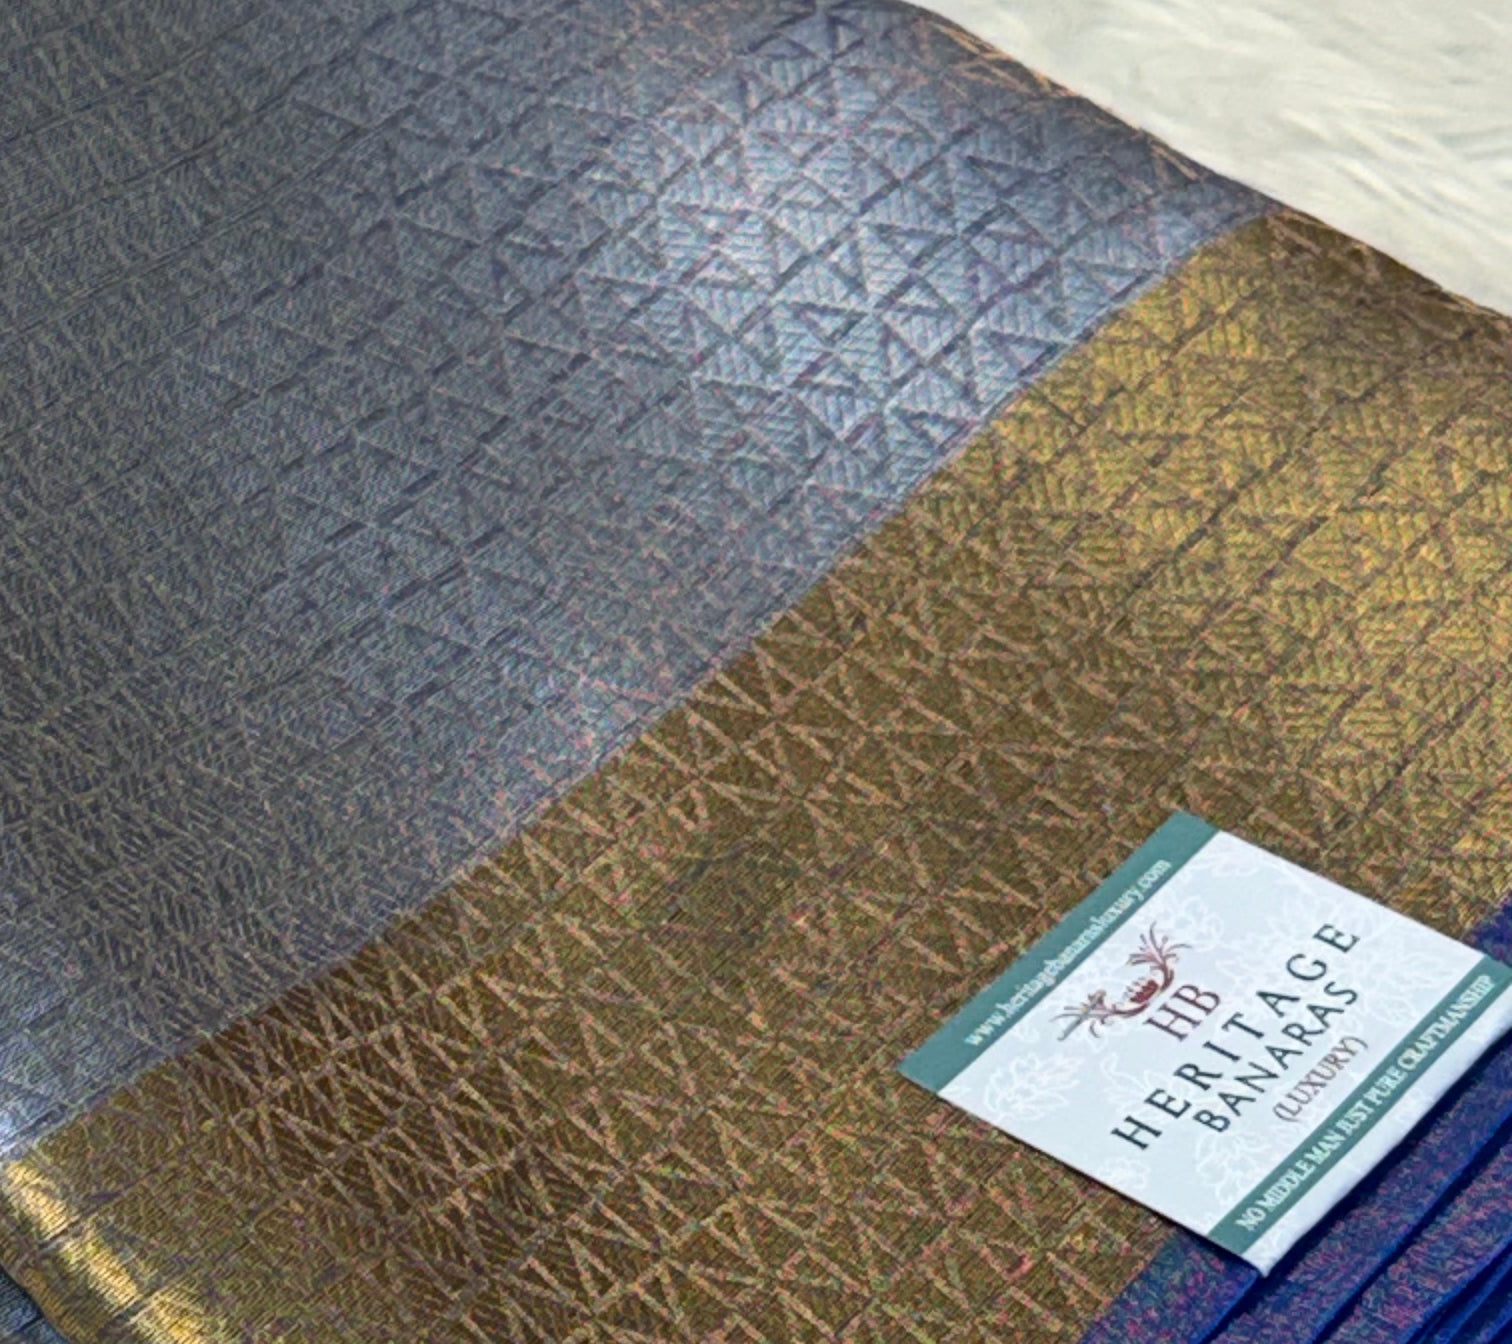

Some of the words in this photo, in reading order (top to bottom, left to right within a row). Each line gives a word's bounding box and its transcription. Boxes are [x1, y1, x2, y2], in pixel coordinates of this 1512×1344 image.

[1110, 923, 1360, 1150] HERITAGE
[1143, 983, 1220, 1042] HB
[1192, 981, 1358, 1133] BANARAS
[1273, 1035, 1368, 1122] (LUXURY)
[1234, 1207, 1266, 1232] NO
[1256, 1159, 1316, 1213] MIDDLE
[1304, 1128, 1346, 1165] MAN
[1335, 1100, 1374, 1136] JUST
[1363, 1065, 1408, 1105] PURE
